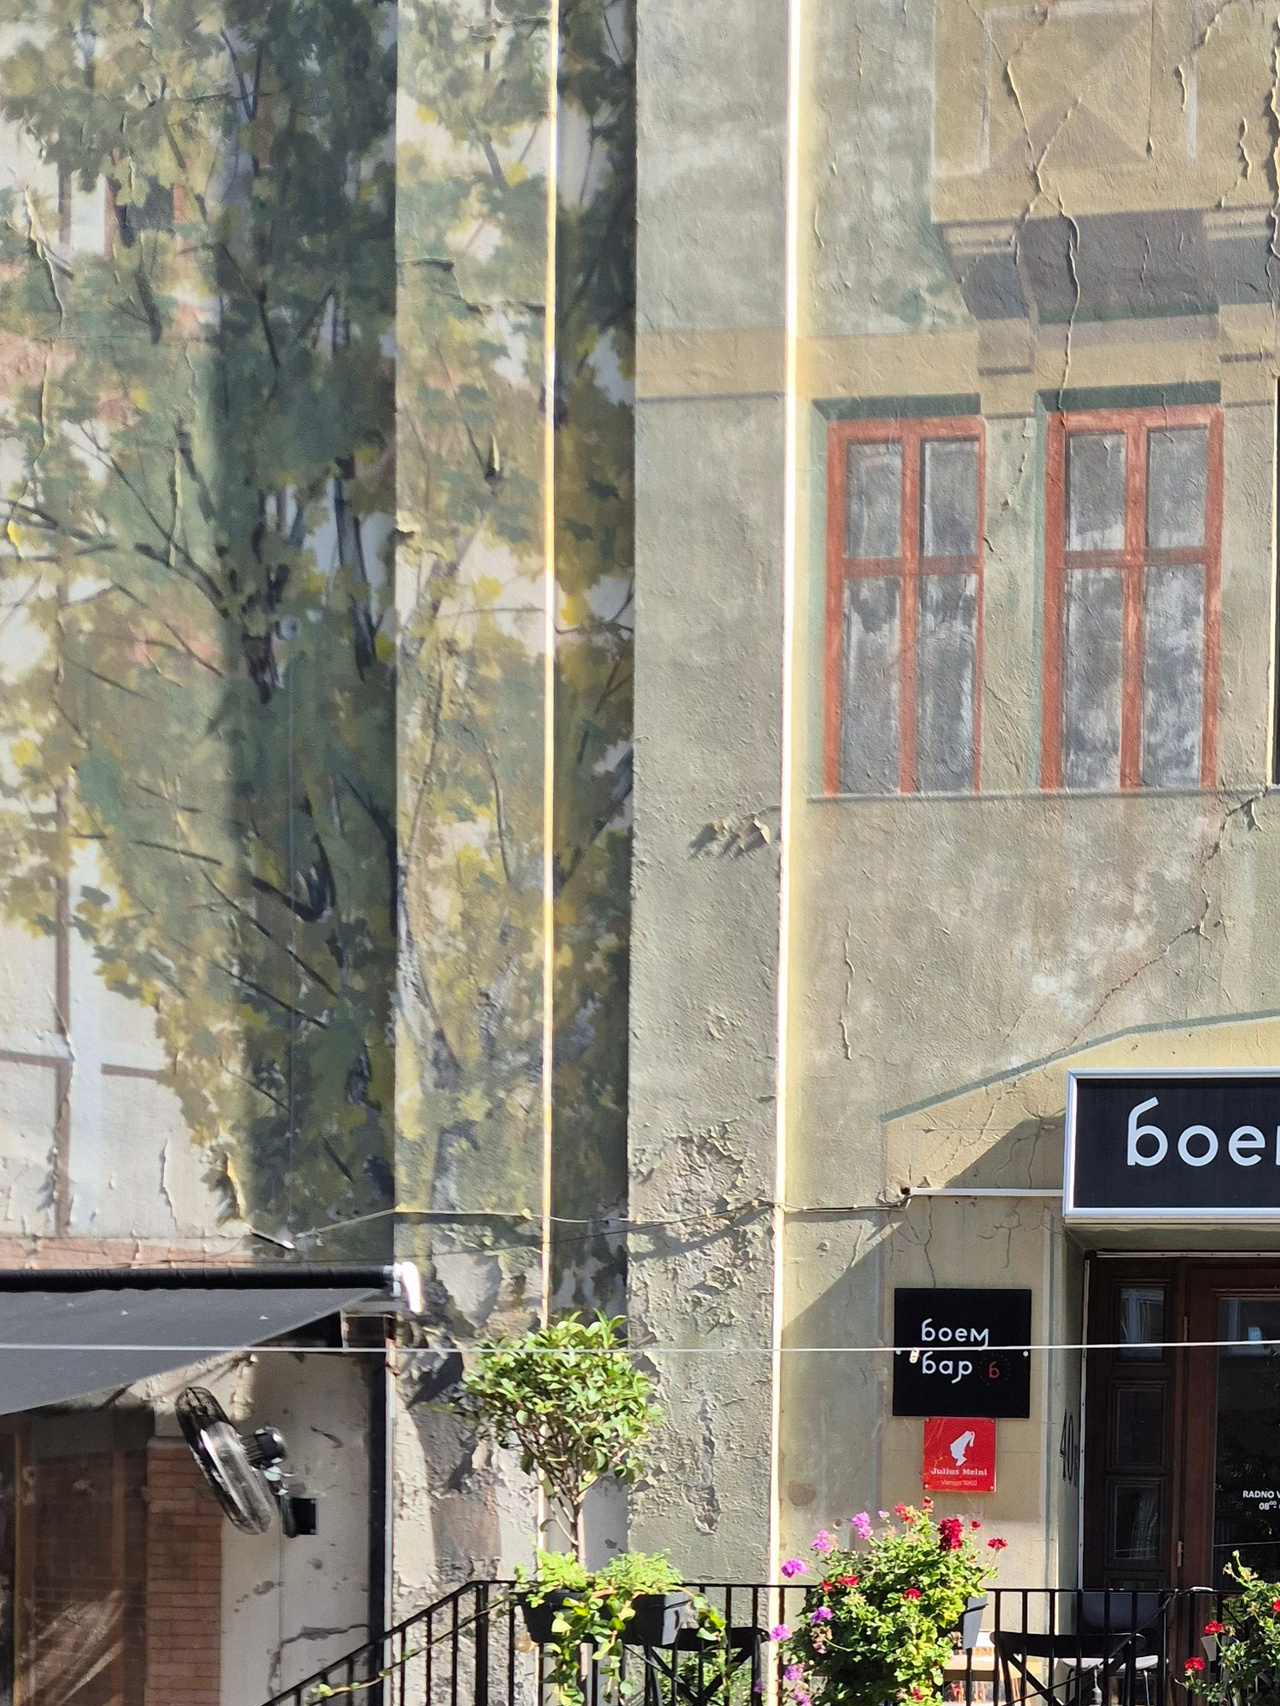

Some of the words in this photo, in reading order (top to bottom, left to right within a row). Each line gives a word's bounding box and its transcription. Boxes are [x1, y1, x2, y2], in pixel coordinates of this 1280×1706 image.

[931, 1467, 960, 1476] Julius
[962, 1468, 988, 1476] Meinl
[1242, 1490, 1275, 1499] RADNO
